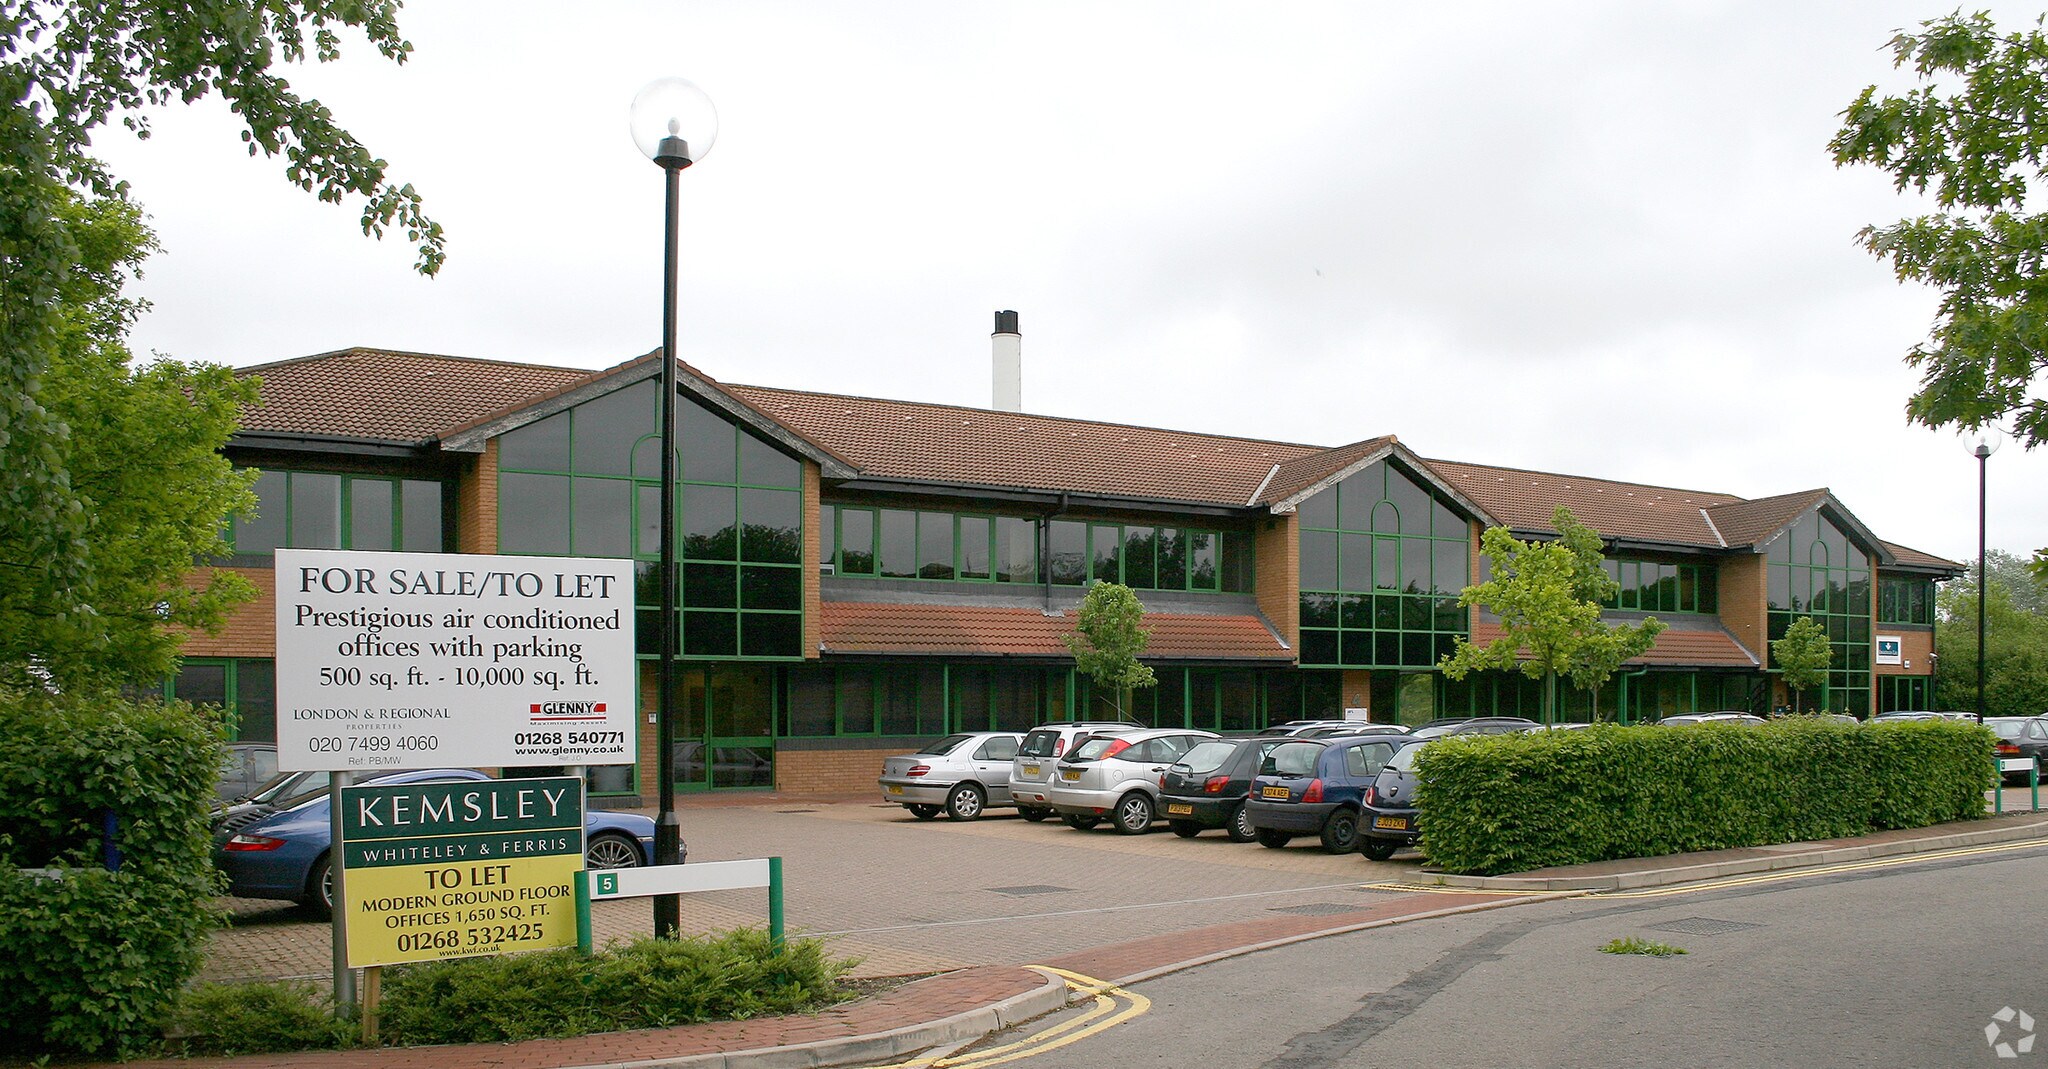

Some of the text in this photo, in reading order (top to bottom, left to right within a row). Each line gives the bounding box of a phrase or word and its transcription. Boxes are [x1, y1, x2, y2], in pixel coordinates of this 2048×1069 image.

[300, 567, 616, 598] FOR SALE/TO LET
[295, 604, 620, 633] Prestigious air conditioned
[338, 632, 582, 663] offices with parking
[320, 667, 361, 686] 500
[369, 672, 398, 690] sq.
[407, 666, 429, 685] ft.
[456, 667, 524, 689] 10,000
[533, 670, 564, 690] sq.
[575, 663, 599, 685] ft.
[294, 708, 451, 720] LONDON & REGIONAL
[543, 702, 594, 714] GLENNY
[309, 735, 439, 752] 020 7499 4060
[514, 731, 624, 745] 01268 540771
[348, 756, 401, 765] Ref: PB/MW
[515, 745, 624, 756] www.glenny.co.uk
[359, 788, 566, 827] KEMSLEY
[363, 838, 567, 861] WHITELEY & FERRIS
[424, 865, 511, 889] TO LET
[603, 877, 612, 890] 5
[362, 884, 570, 912] MODERN GROUND FLOOR
[385, 903, 550, 929] OFFICES 1,650 SQ. FT.
[397, 922, 544, 952] 01268 532425
[439, 944, 501, 957] www.kwf.co.uk
